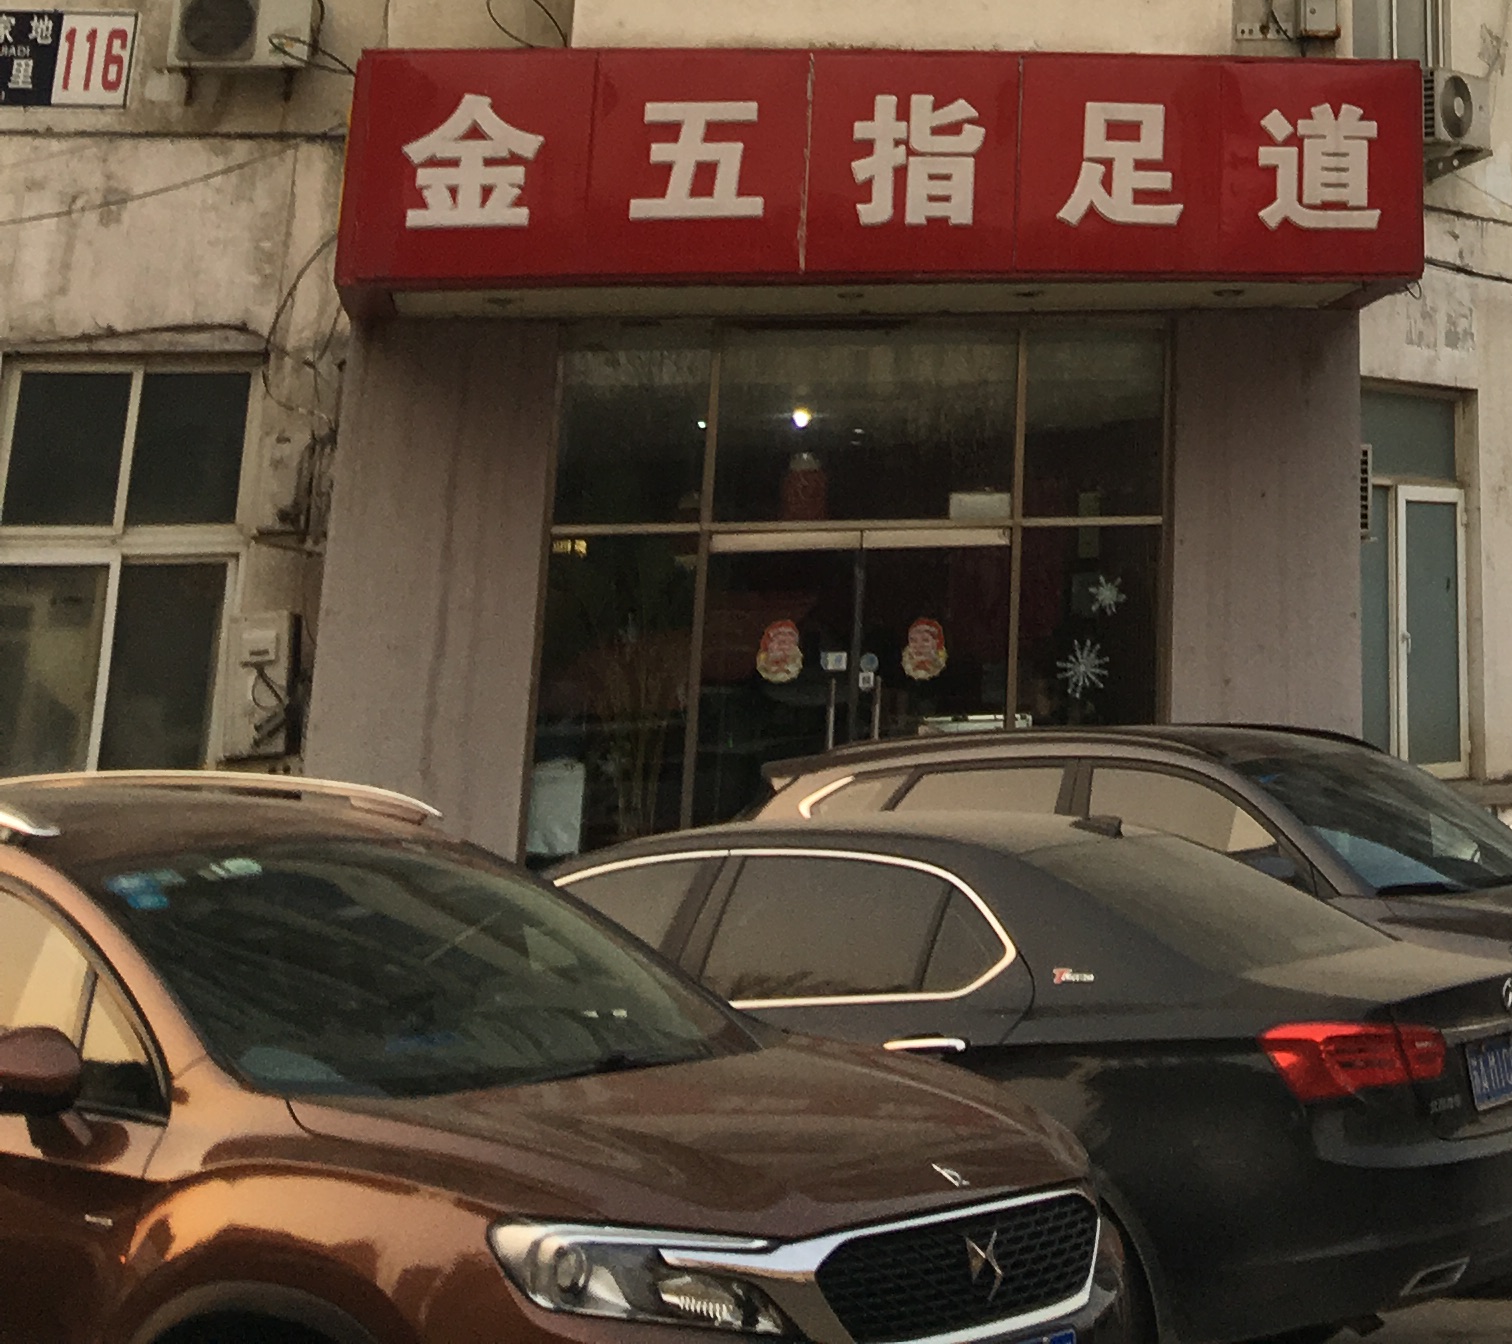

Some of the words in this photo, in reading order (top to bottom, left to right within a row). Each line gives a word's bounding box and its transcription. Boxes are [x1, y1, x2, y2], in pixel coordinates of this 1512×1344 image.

[62, 26, 128, 93] 116
[401, 92, 1383, 232] 金五指足道
